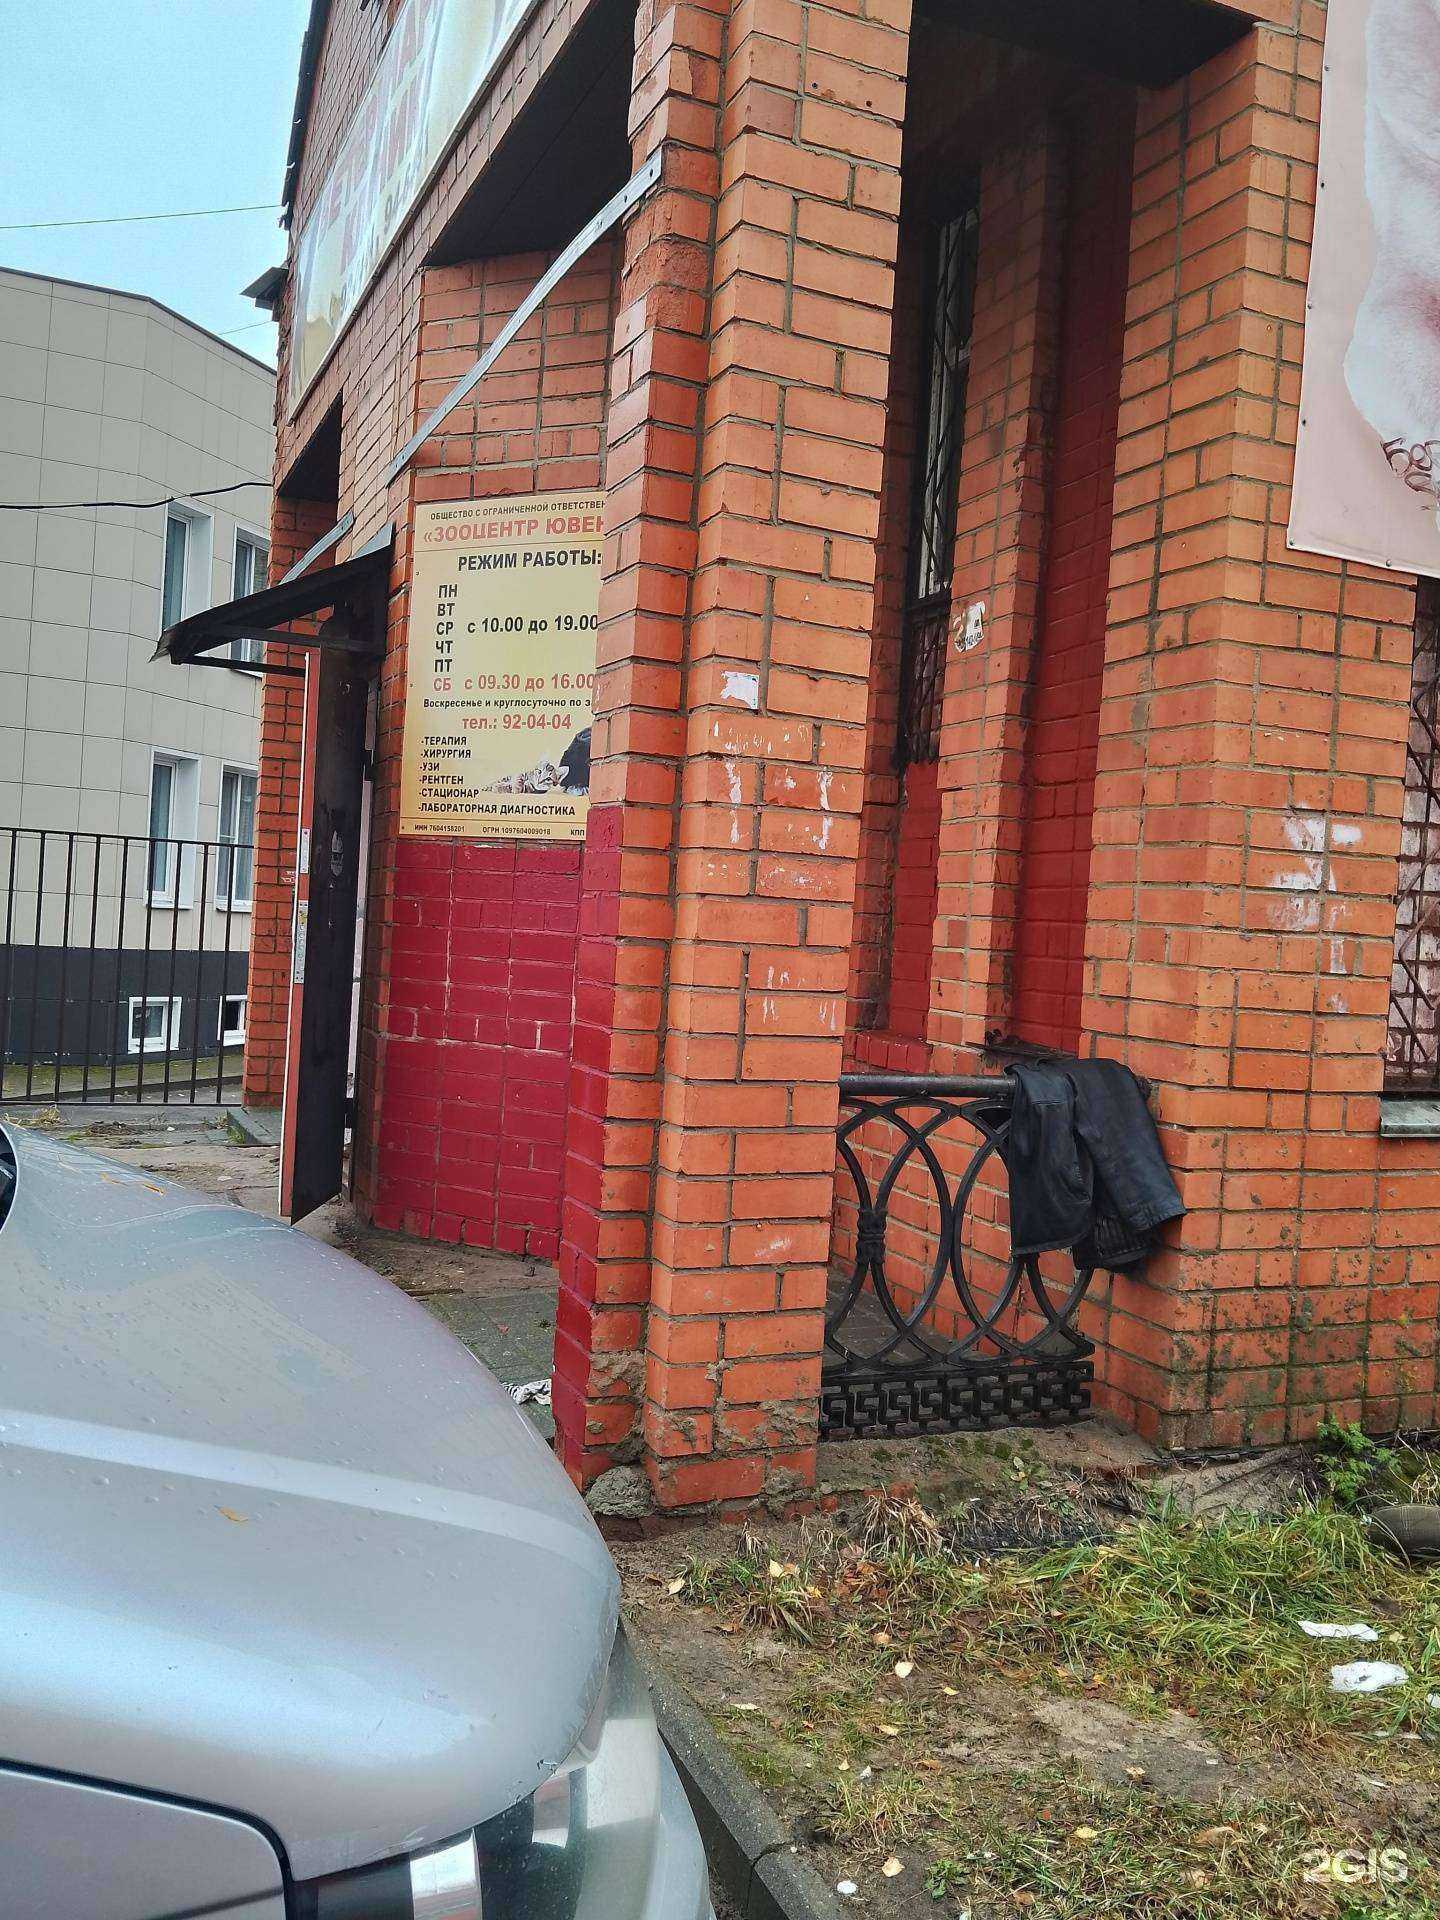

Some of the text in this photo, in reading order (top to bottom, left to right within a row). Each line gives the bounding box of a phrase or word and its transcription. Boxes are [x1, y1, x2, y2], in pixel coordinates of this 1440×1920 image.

[431, 509, 473, 520] ОБЩЕСТВО
[482, 504, 548, 516] ОГРАНИЧЕННОЙ
[424, 519, 538, 543] «ЗООЦЕНТР
[458, 550, 601, 571] РЕЖИМ РАБОТЫ:
[438, 584, 458, 598] ПН
[437, 603, 455, 616] ВТ
[436, 614, 598, 636] СР с 10.00 до 19.00
[435, 640, 453, 654] ЧТ
[434, 659, 452, 672] ПТ
[434, 674, 594, 692] СБ с 09.30 до 16.00
[424, 698, 482, 708] Воскресенье
[494, 700, 566, 709] круглосуточно
[462, 714, 572, 730] тел.: 92-04-04
[421, 736, 467, 746] -ТЕРАПИЯ
[420, 750, 472, 758] -ХИРУРГИЯ
[420, 762, 440, 771] -УЗИ
[419, 776, 464, 784] -РЕНТГЕН
[418, 789, 480, 798] -СТАЦИОНАР
[418, 802, 576, 816] -ЛАБОРАТОРНАЯ ДИАГНОСТИКА
[430, 824, 464, 832] 7604158201
[482, 826, 500, 834] ОГРН
